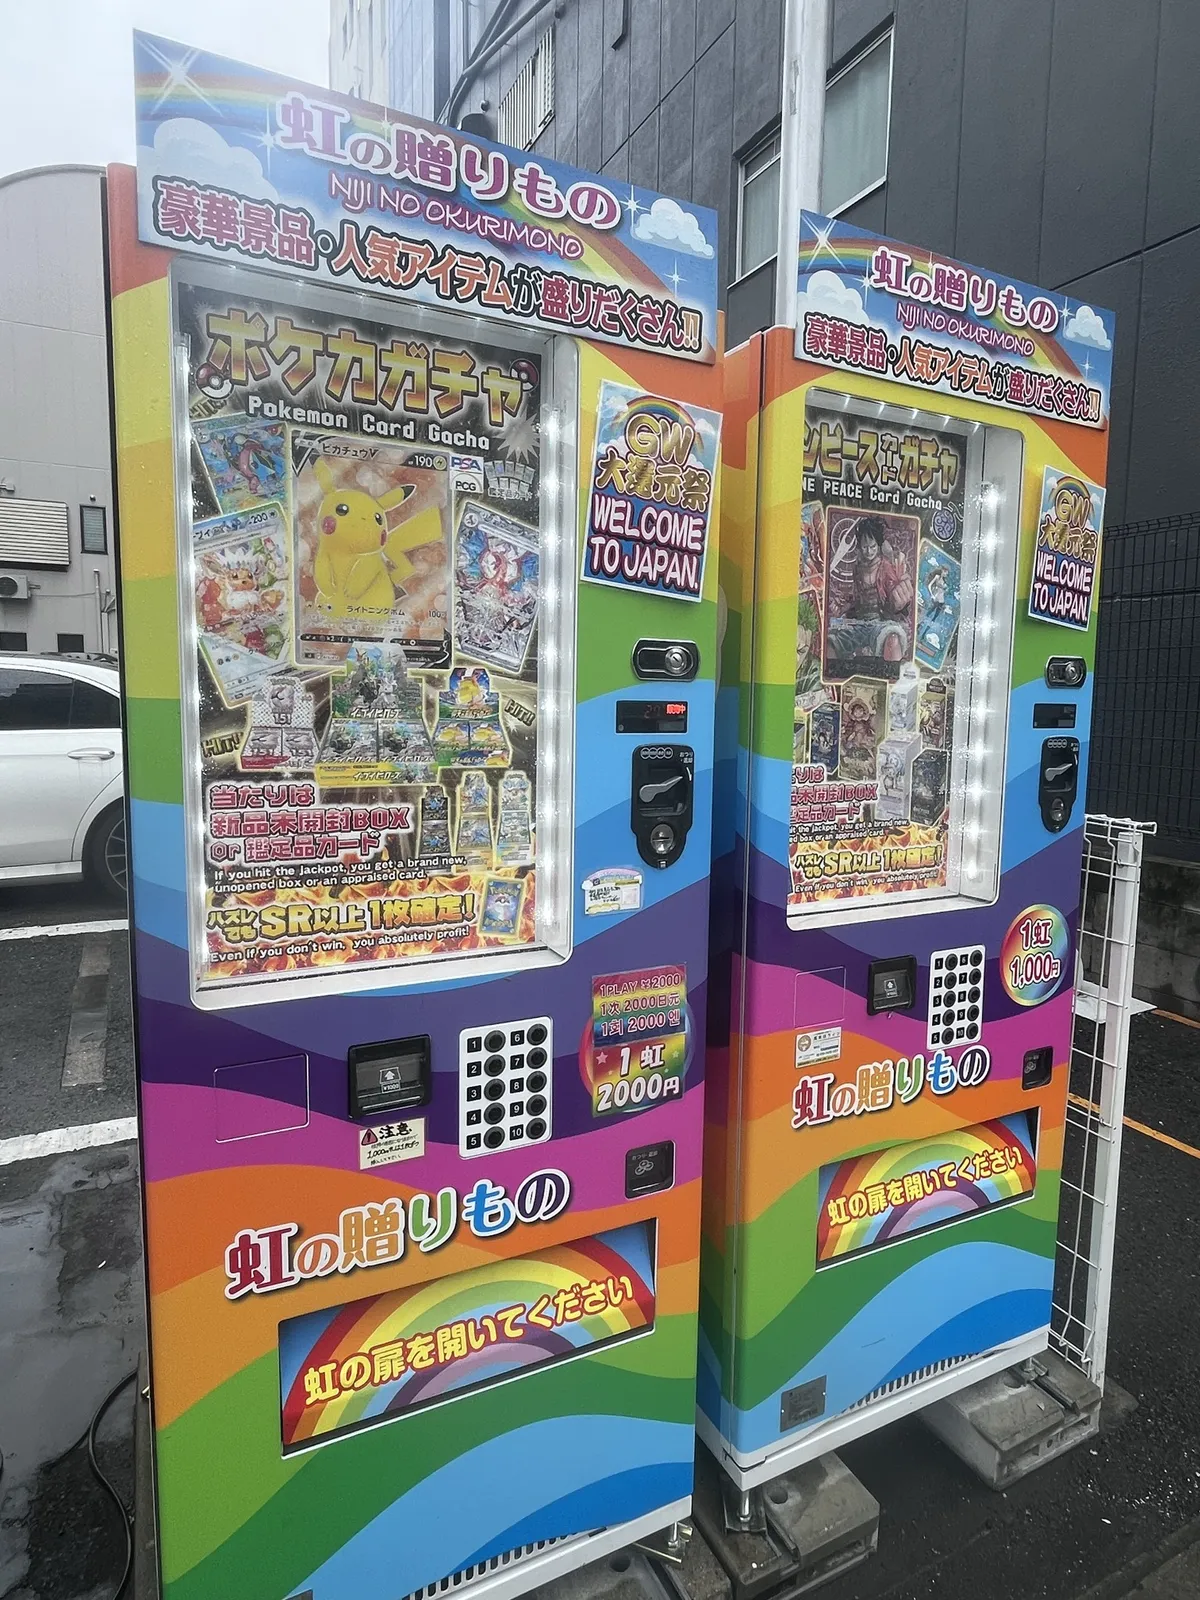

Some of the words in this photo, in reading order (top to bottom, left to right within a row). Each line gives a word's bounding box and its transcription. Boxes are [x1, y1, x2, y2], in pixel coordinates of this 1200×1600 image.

[276, 92, 622, 232] 虹の贈りもの
[329, 171, 373, 213] NIJI
[379, 184, 421, 217] NO
[424, 201, 584, 260] OKURIMONO
[871, 245, 1060, 333] 虹の贈りもの
[897, 302, 920, 331] NIJI
[922, 309, 947, 332] NO
[948, 317, 1036, 357] OKURIMONO
[205, 308, 525, 427] ポケカガチャ
[248, 395, 348, 430] Pokemon
[361, 412, 416, 440] Card
[428, 422, 490, 451] Gacha
[625, 413, 695, 466] GW
[414, 455, 433, 467] 190
[451, 456, 482, 471] PSA
[455, 480, 477, 491] PCG
[823, 480, 863, 499] PEACE
[870, 488, 899, 505] Card
[907, 493, 942, 510] Gacha
[592, 493, 704, 552] WELCOME
[1055, 489, 1090, 530] GW
[590, 535, 621, 579] TO
[1036, 550, 1093, 594] WELCOME
[1033, 582, 1049, 613] TO
[273, 713, 292, 725] 151
[210, 784, 315, 810] 当たりは
[209, 806, 411, 838] 新品未開封BOX
[798, 824, 810, 833] the
[840, 823, 853, 832] you
[800, 834, 812, 842] box
[245, 832, 381, 863] 鑑定品カード
[215, 880, 275, 893] unopened
[278, 877, 301, 888] box
[306, 876, 321, 886] or
[322, 875, 338, 885] an
[341, 871, 396, 885] appraised
[228, 870, 251, 882] you
[255, 868, 271, 878] hit
[275, 865, 295, 876] the
[351, 861, 371, 873] you
[374, 861, 394, 872] get
[408, 857, 439, 872] brand
[795, 883, 813, 893] Even
[207, 908, 258, 929] ハズレ
[210, 950, 243, 963] Even
[259, 947, 282, 960] you
[286, 941, 318, 956] don't
[352, 937, 375, 949] you
[378, 930, 434, 946] absolutely
[436, 926, 470, 940] profit!
[1010, 952, 1060, 988] 1,000円
[600, 980, 638, 998] 1PLAY
[600, 1001, 621, 1017] 1次
[623, 992, 680, 1013] 2000日元
[600, 1018, 624, 1037] 1회
[627, 1012, 666, 1034] 2000
[668, 1008, 681, 1026] 엔
[620, 1045, 632, 1078] 1
[640, 1043, 665, 1070] 虹
[597, 1073, 681, 1112] 2000円
[791, 1045, 991, 1129] 虹の贈りもの
[827, 1146, 1023, 1227] 虹の扉を開いてください
[224, 1167, 571, 1301] 虹の贈りもの
[303, 1274, 635, 1406] 虹の扉を開いてください
